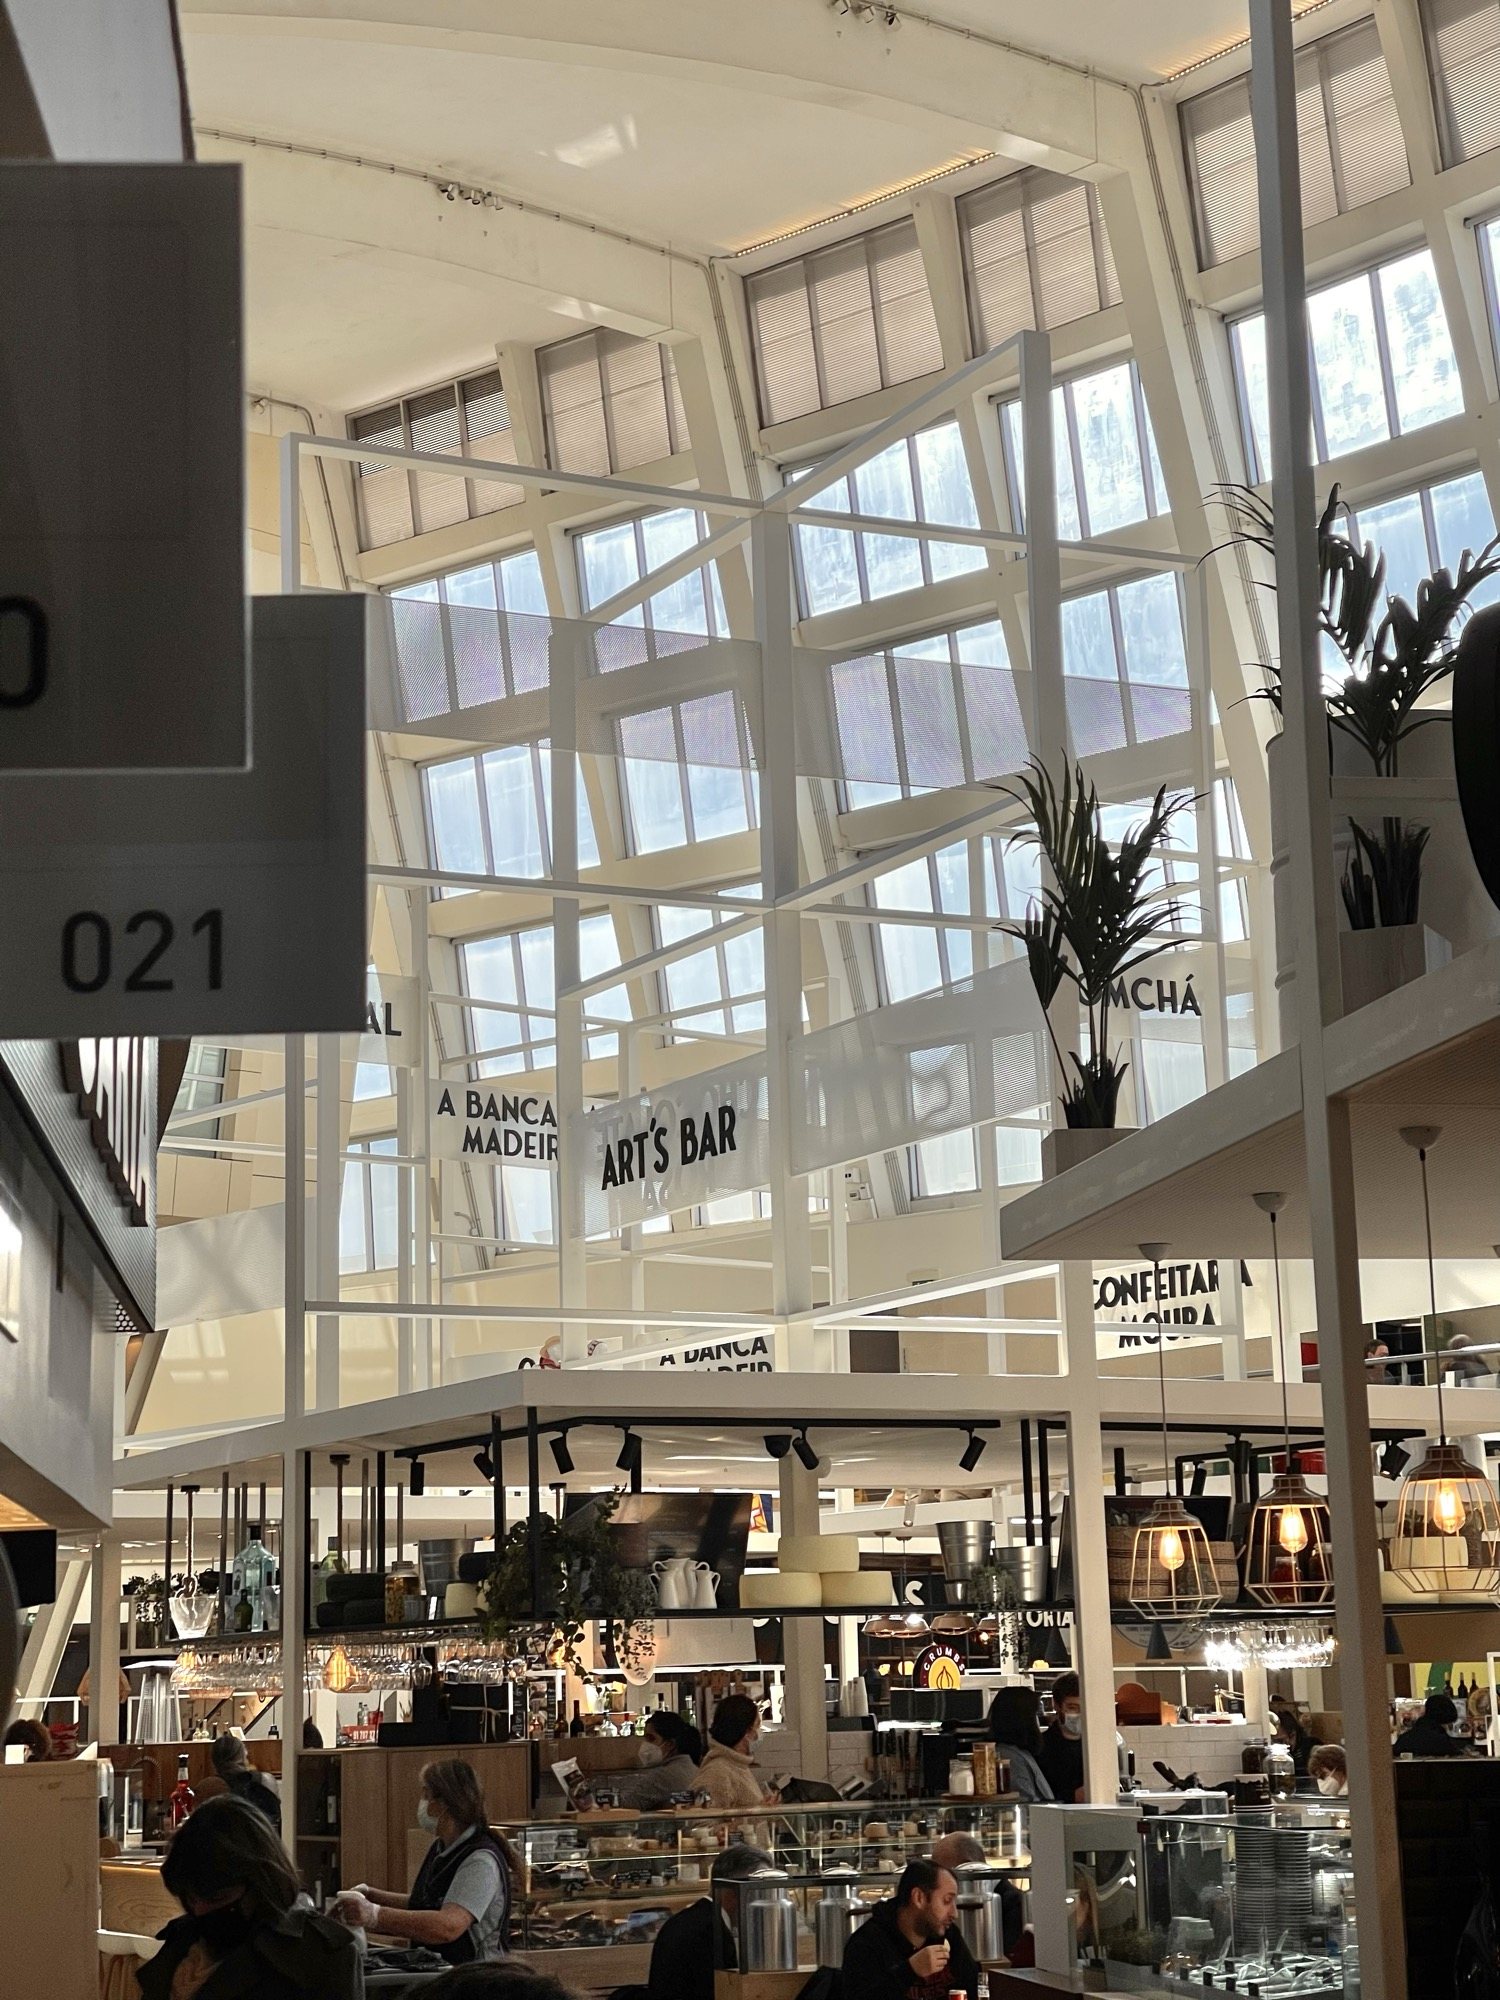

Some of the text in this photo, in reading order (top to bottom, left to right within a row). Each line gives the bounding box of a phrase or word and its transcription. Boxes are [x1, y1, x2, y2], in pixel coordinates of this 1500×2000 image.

[61, 909, 223, 993] 021
[437, 1088, 557, 1127] A BANCA
[602, 1105, 737, 1190] ART'S BAR
[1093, 1259, 1253, 1310] ONFEITARA
[923, 1646, 966, 1671] CRUMBS
